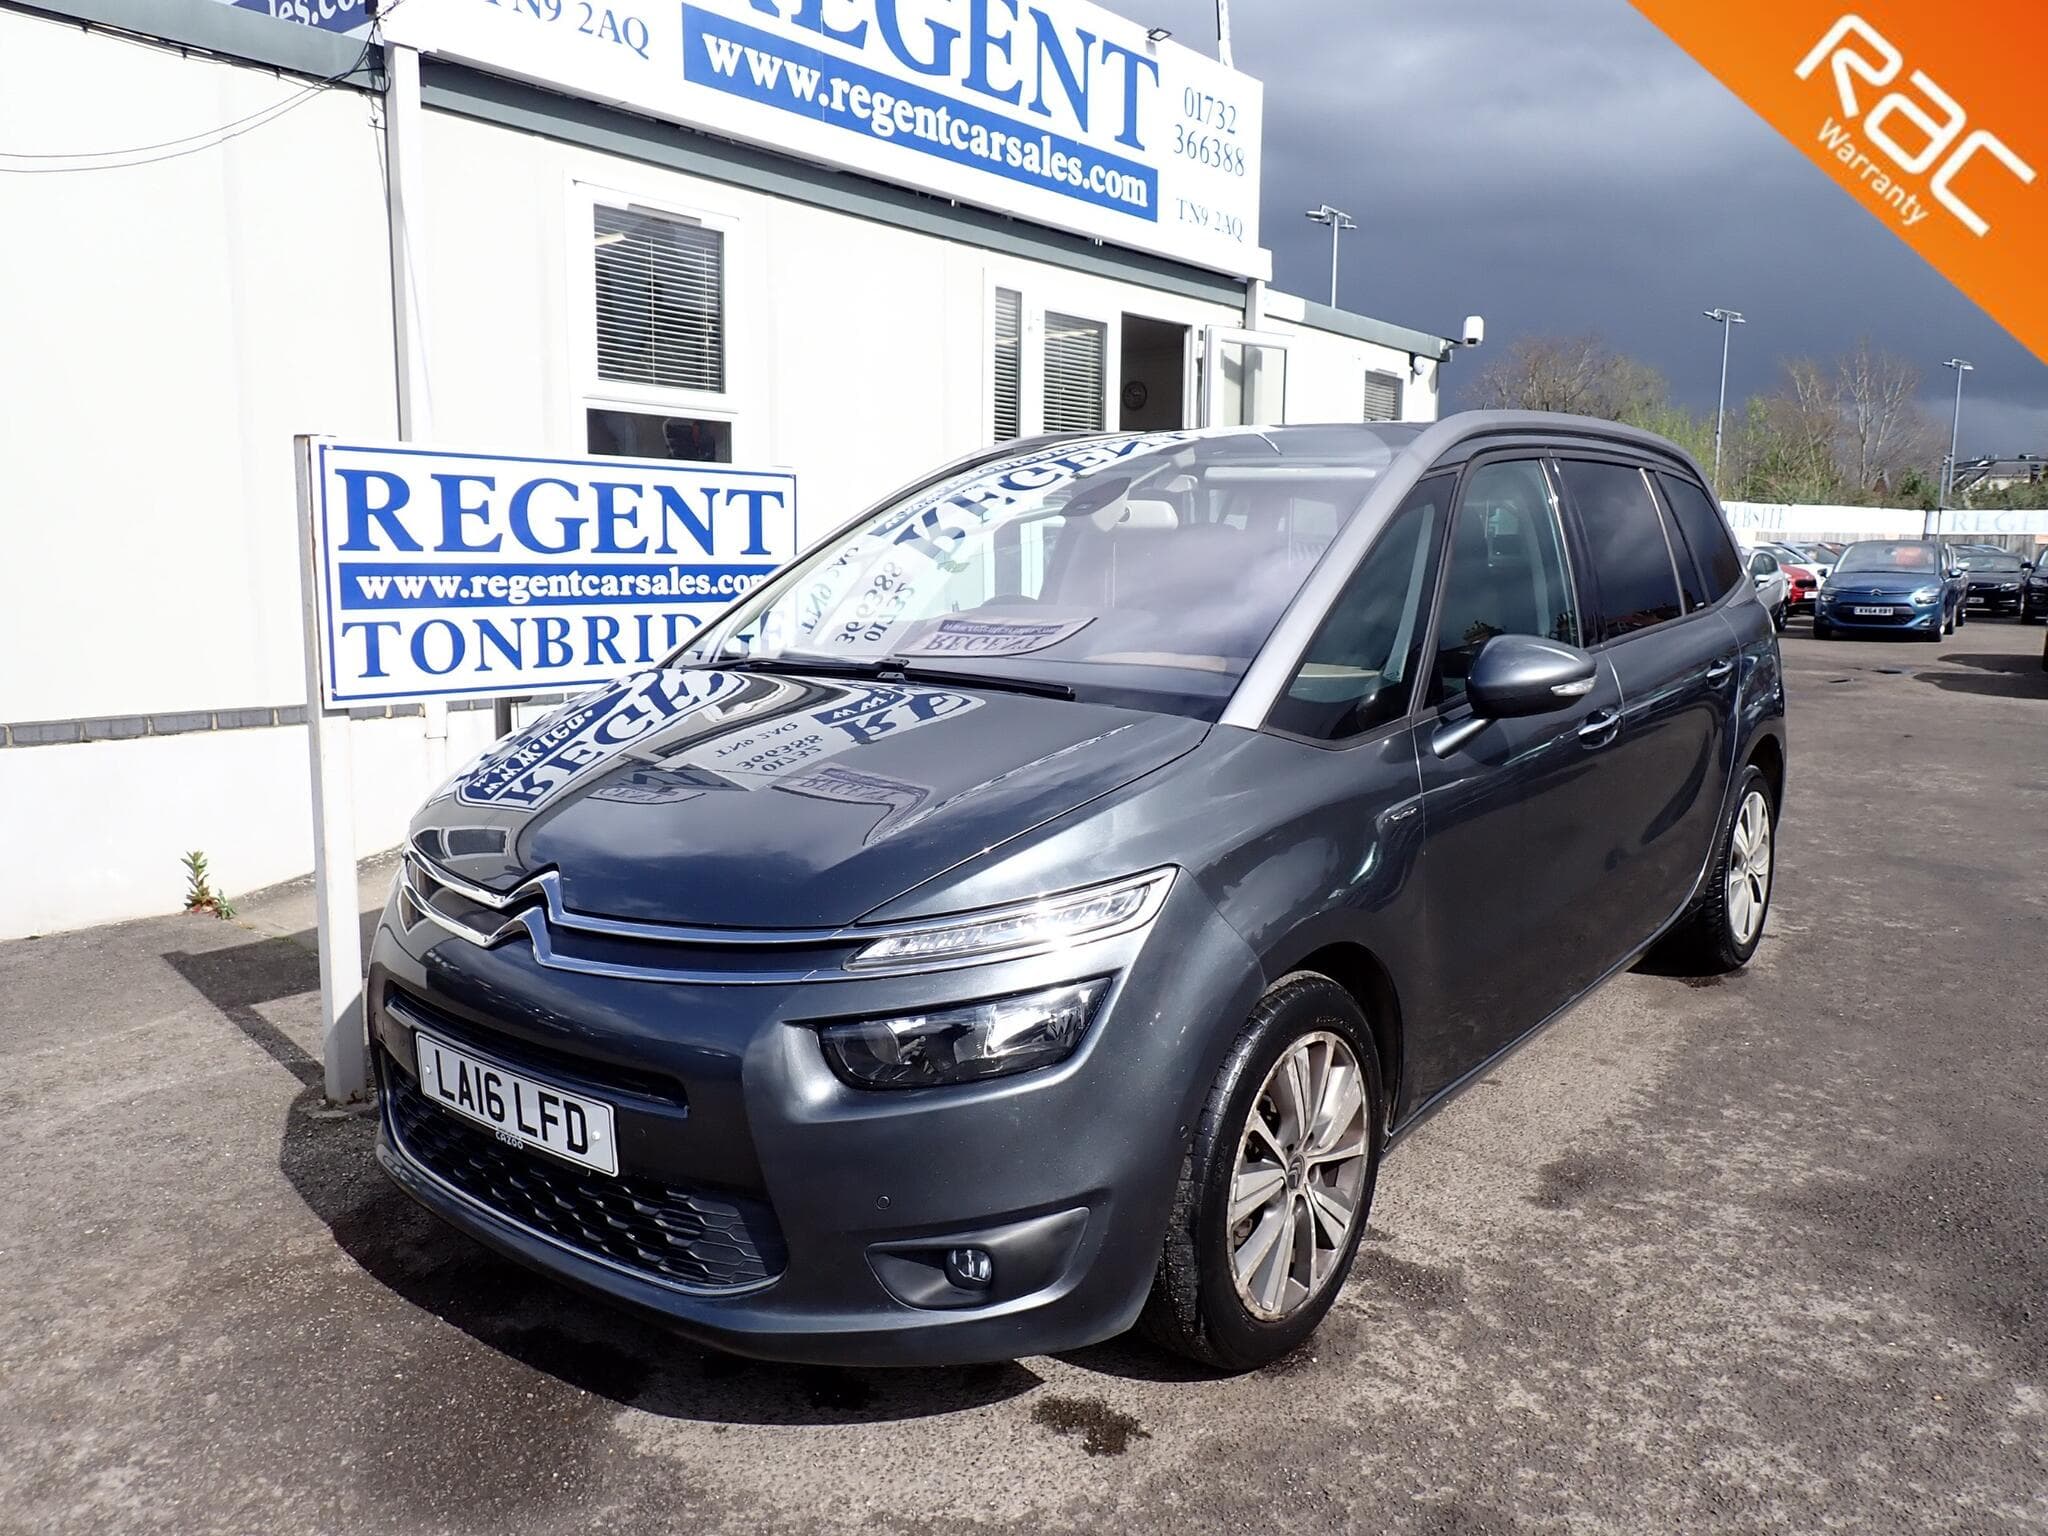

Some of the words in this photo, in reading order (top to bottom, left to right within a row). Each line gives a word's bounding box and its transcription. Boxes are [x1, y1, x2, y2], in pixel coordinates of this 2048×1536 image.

[577, 1, 649, 60] 2AQ
[748, 0, 1160, 152] GENT
[701, 32, 1149, 208] www.regentcarsales.com
[1184, 86, 1237, 134] 01732
[1174, 124, 1245, 177] 366388
[1176, 197, 1210, 226] TN9
[1214, 211, 1243, 243] 2AQ
[334, 468, 785, 556] REGENT
[341, 612, 704, 678] TONBRID
[435, 1049, 505, 1123] LA16
[513, 1082, 588, 1156] LFD
